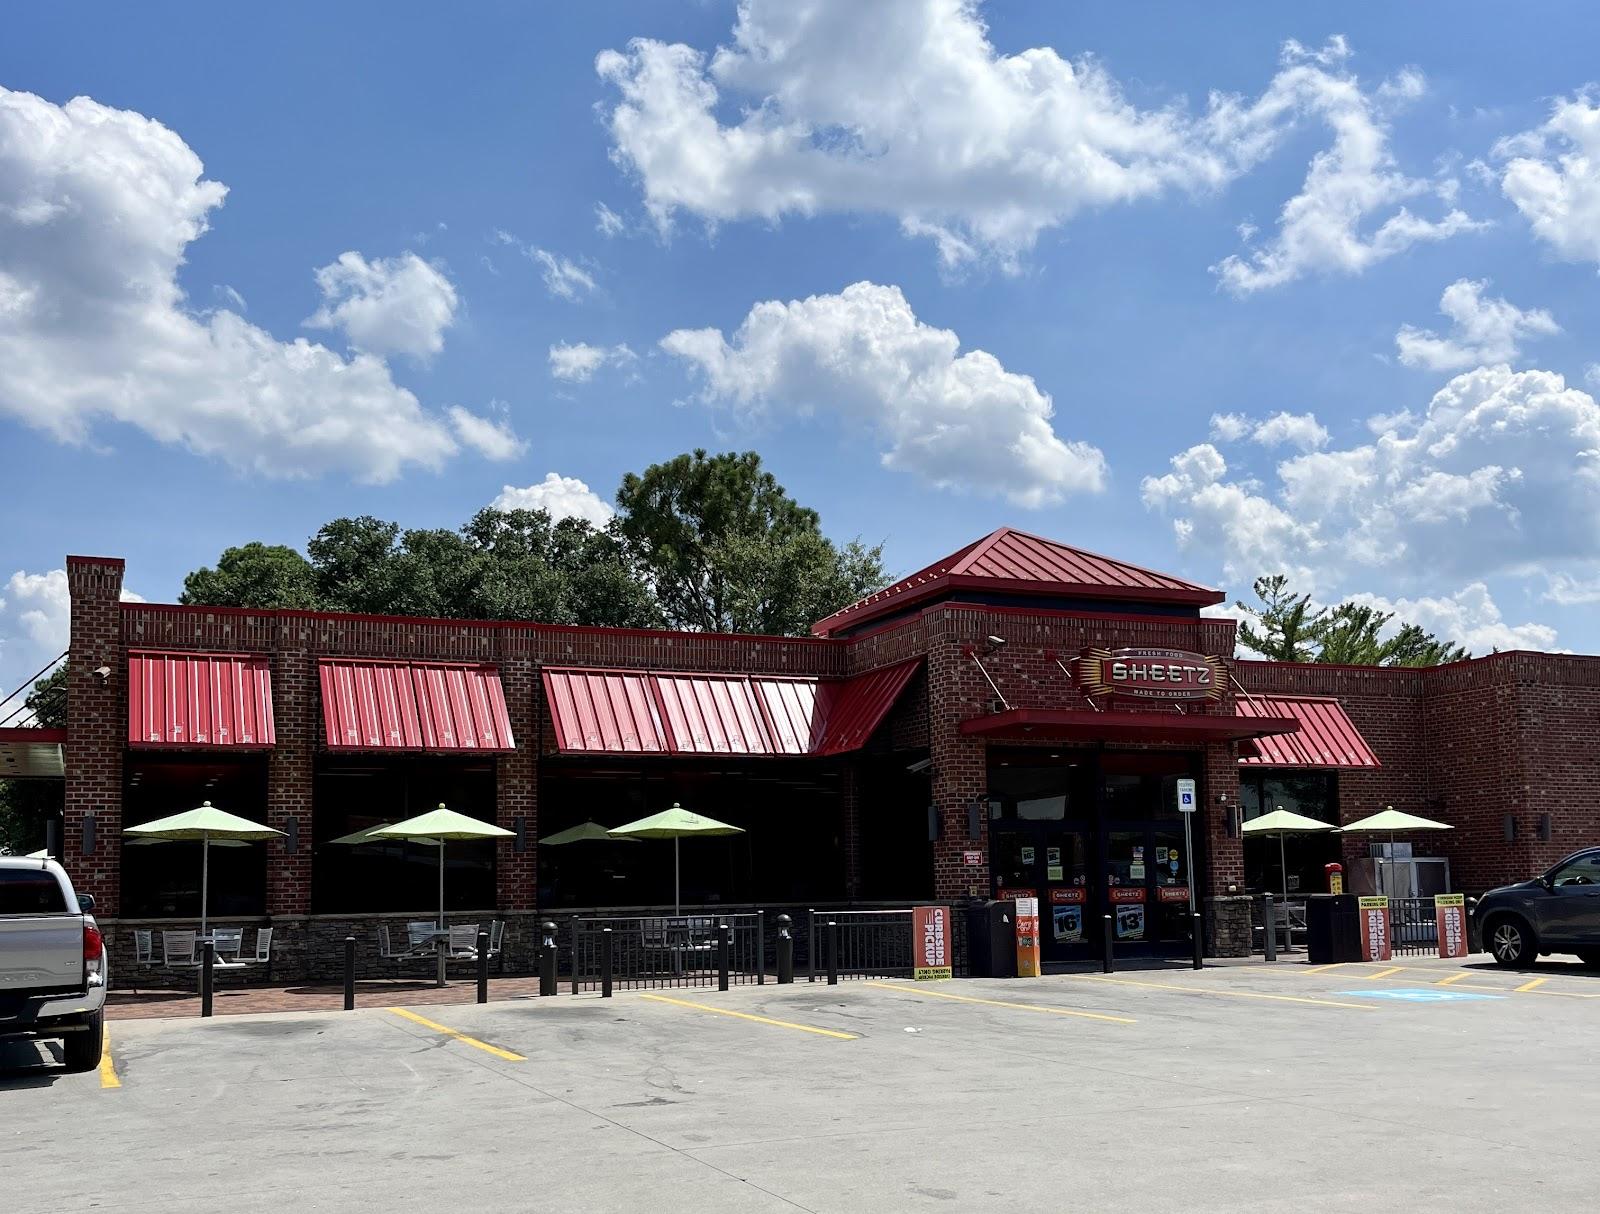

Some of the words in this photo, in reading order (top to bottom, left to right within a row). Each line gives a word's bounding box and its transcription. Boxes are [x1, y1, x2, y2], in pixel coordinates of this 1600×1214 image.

[1112, 662, 1210, 684] SHEETZ
[925, 924, 935, 966] PICKUP
[934, 909, 944, 965] CURBSIDE
[1368, 910, 1379, 961] CURBSIDE
[1376, 909, 1385, 945] PICKUP
[1444, 907, 1455, 956] CURBSIDE
[1452, 907, 1462, 943] PICKUP
